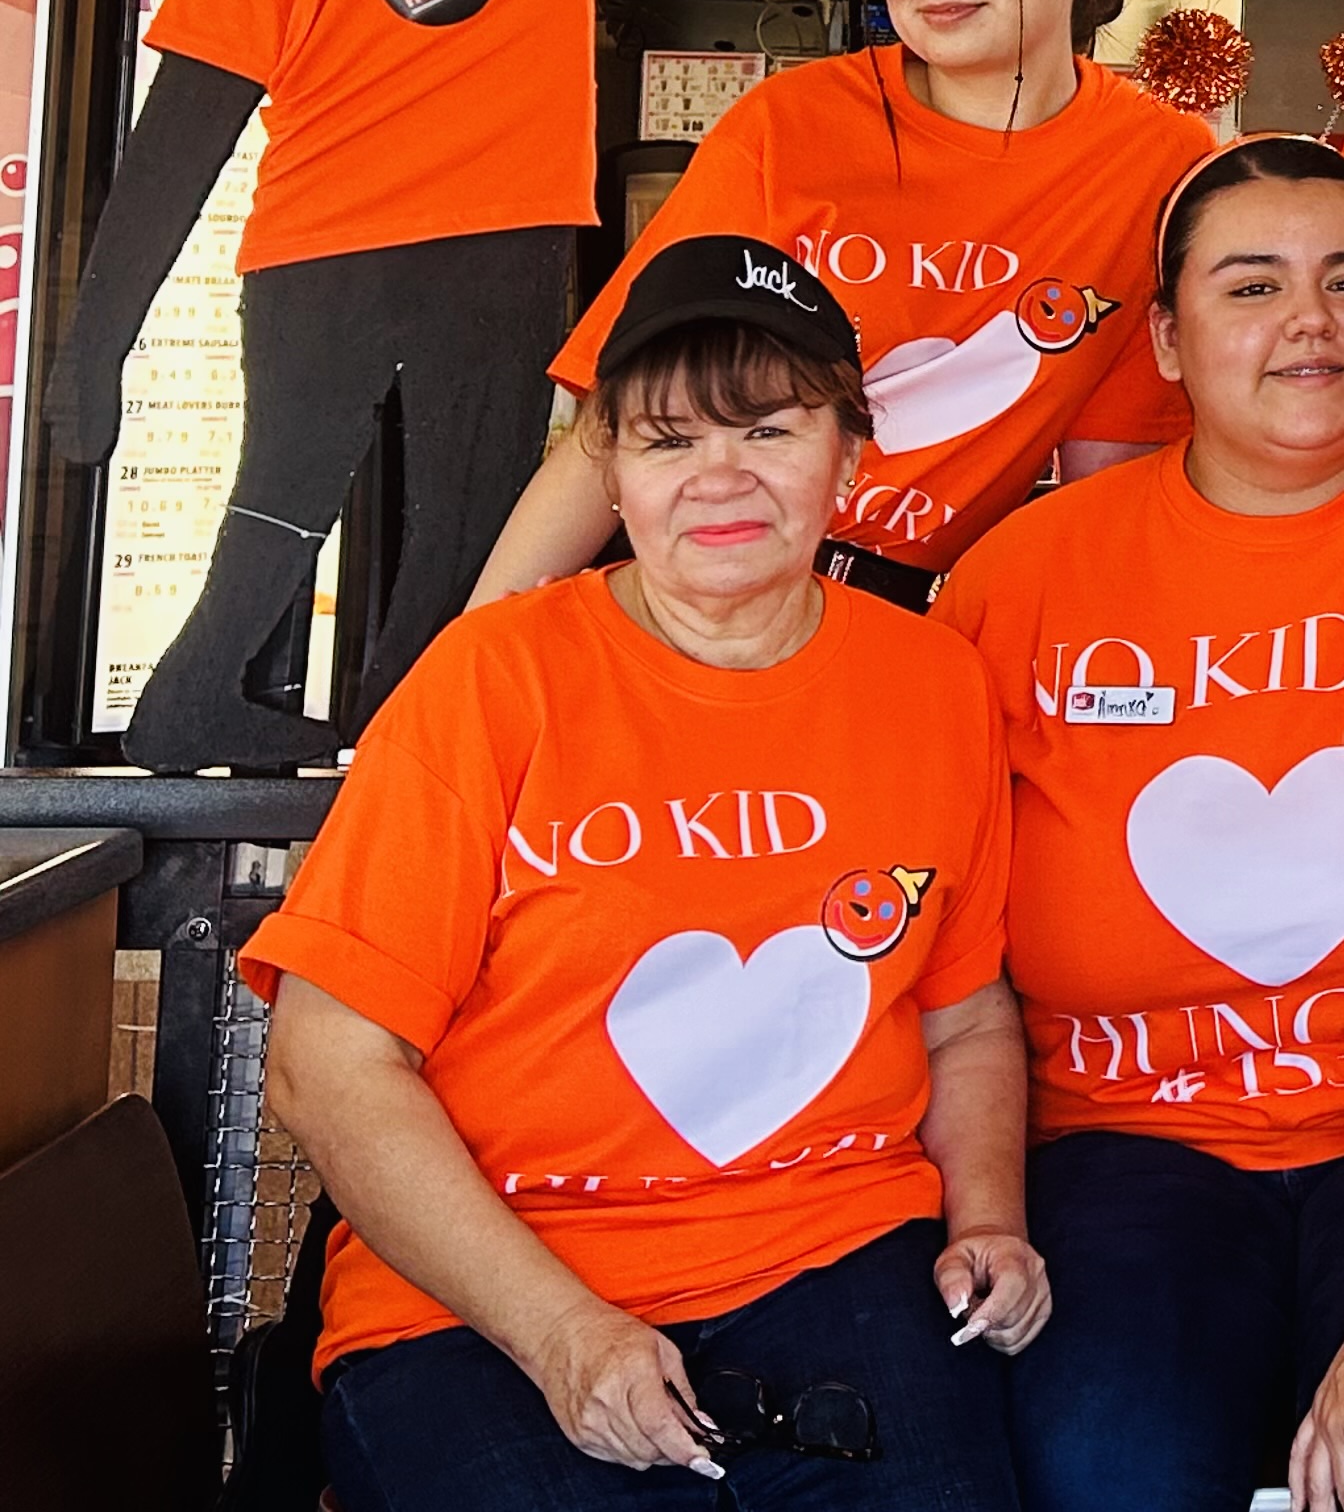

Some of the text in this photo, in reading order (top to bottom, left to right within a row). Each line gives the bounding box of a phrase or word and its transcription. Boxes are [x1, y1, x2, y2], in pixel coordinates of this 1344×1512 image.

[735, 248, 818, 312] Jack
[795, 229, 1020, 294] NO KID
[126, 400, 144, 414] 27
[120, 465, 139, 480] 28
[114, 553, 133, 569] 29
[501, 789, 828, 899] NO KID
